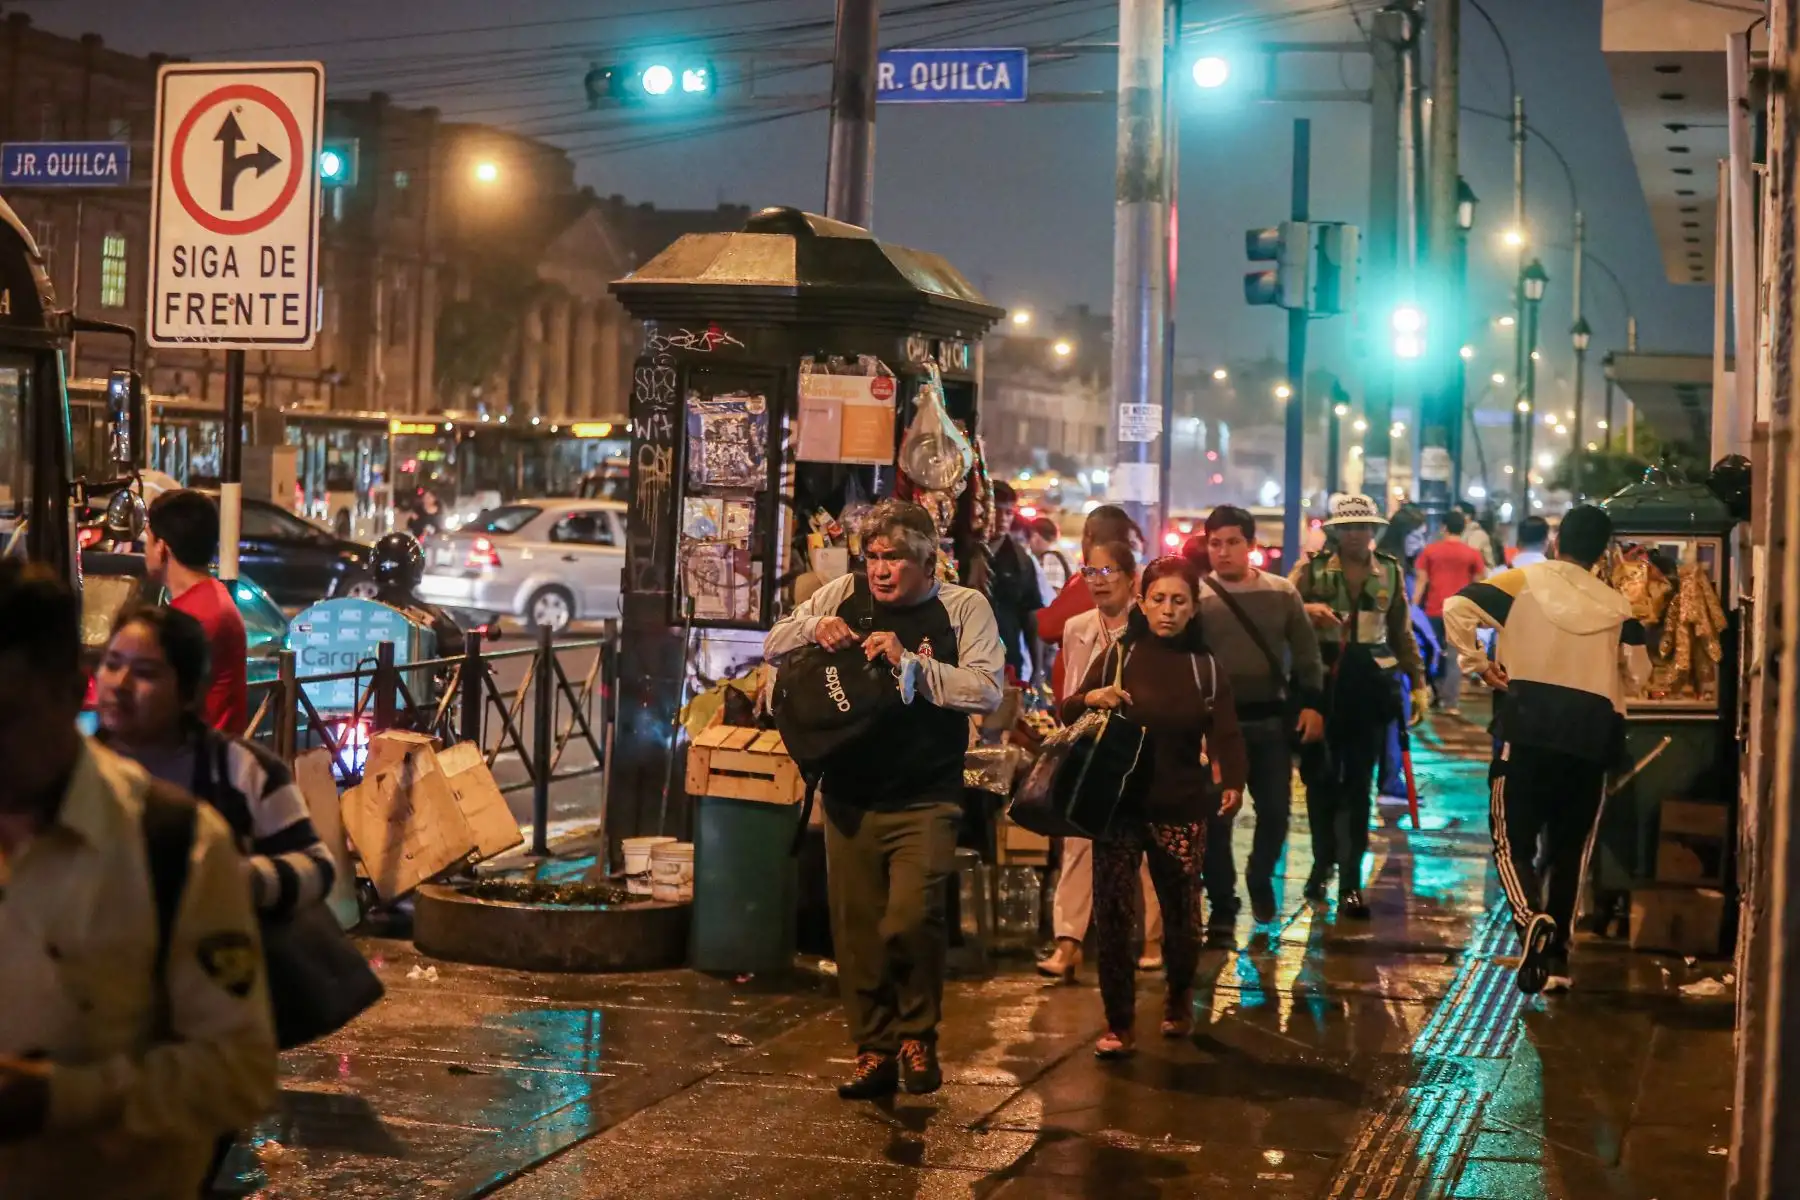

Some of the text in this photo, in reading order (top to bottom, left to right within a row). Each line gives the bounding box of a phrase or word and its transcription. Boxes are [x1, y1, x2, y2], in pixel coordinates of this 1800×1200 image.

[910, 62, 1012, 91] QUILCA
[10, 152, 118, 176] JR. QUILCA
[172, 245, 296, 278] SIGA DE
[165, 292, 300, 325] FRENTE
[825, 665, 851, 712] adidas
